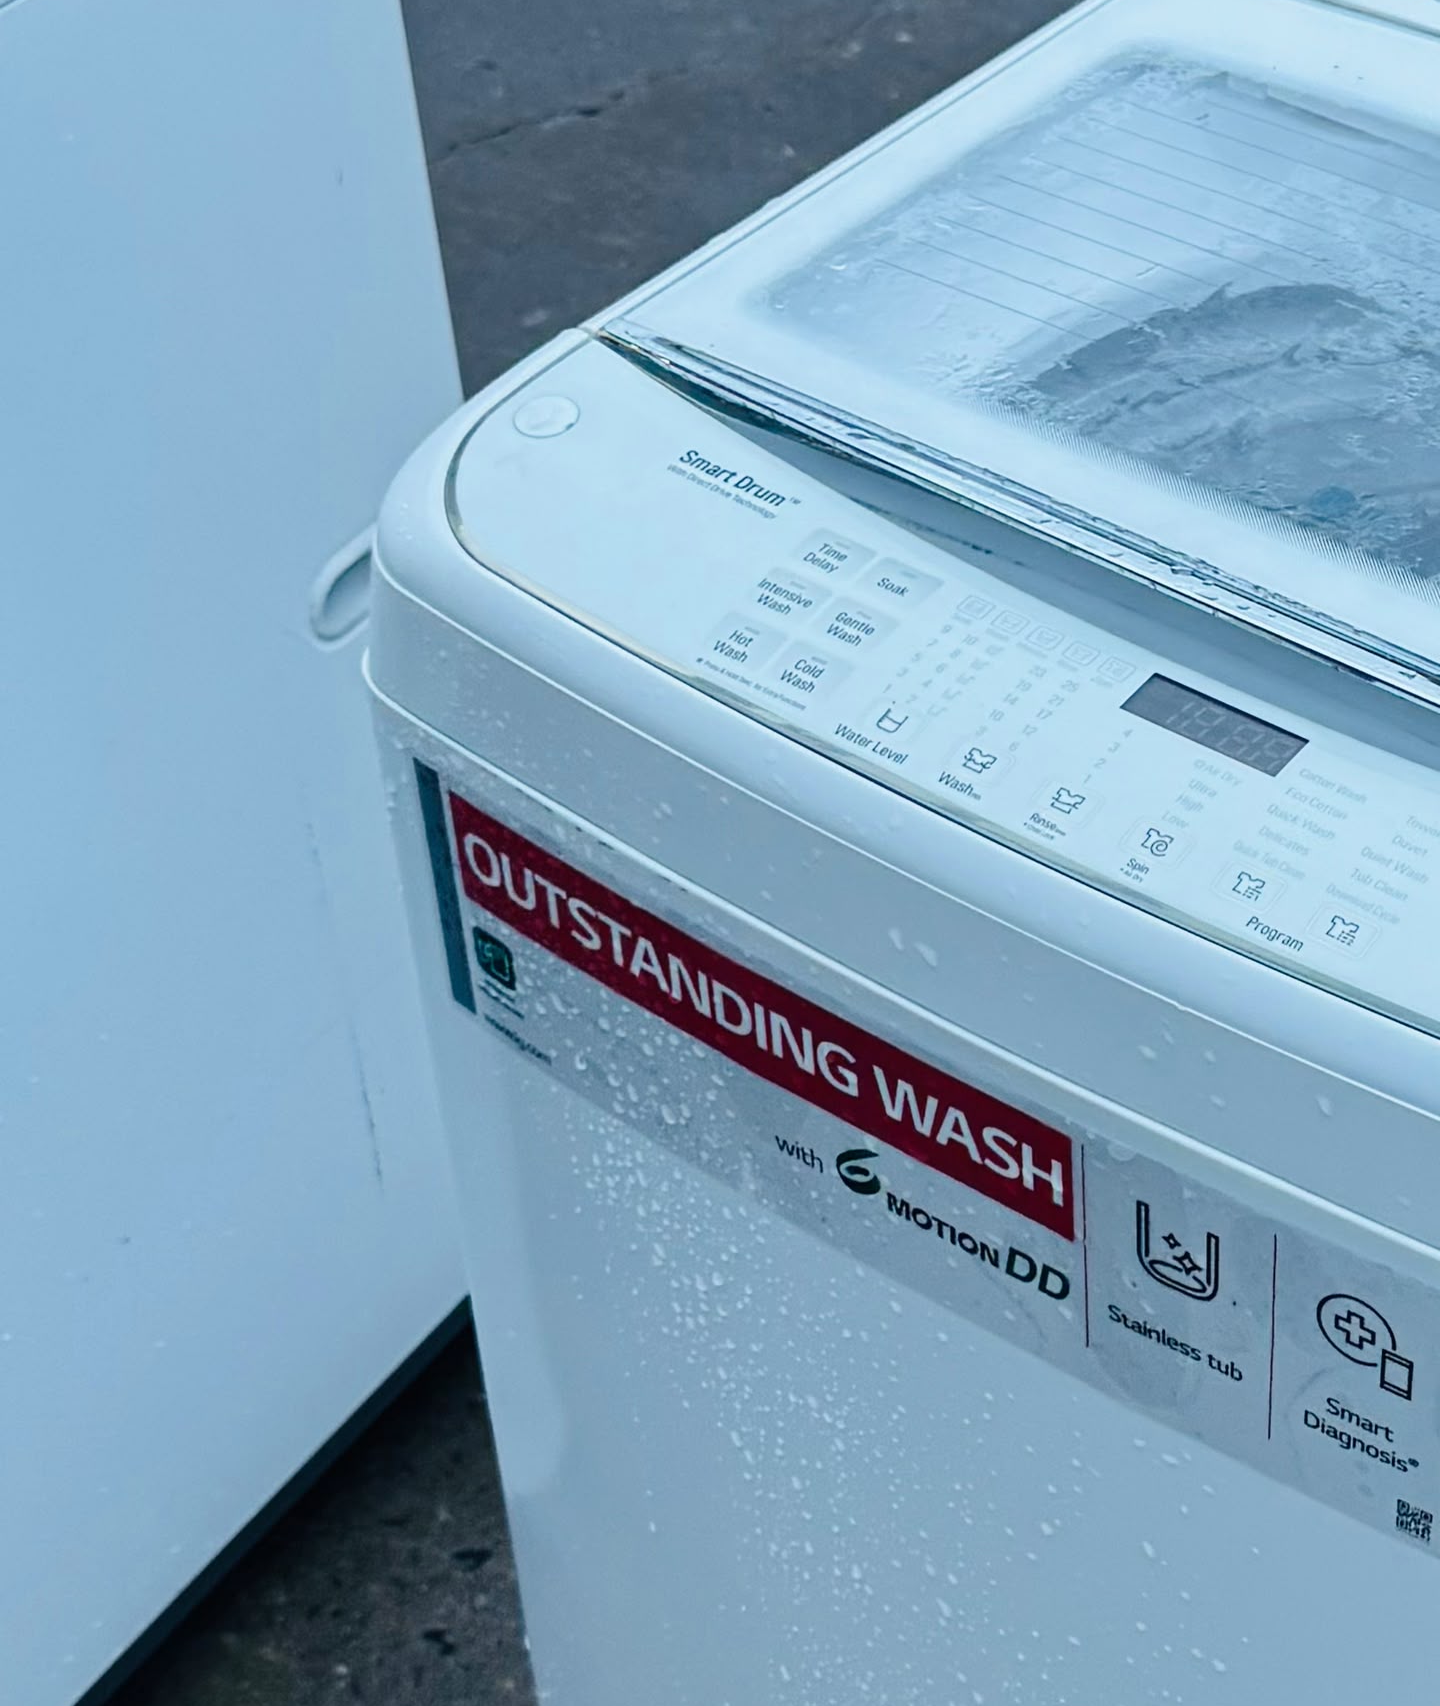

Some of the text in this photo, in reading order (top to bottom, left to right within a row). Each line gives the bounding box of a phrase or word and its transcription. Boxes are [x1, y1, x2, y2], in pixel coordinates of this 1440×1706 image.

[679, 450, 738, 483] Smart
[803, 552, 839, 573] Delay
[819, 543, 848, 562] Time
[757, 578, 813, 609] Intensive
[877, 577, 909, 597] Soak
[757, 593, 792, 615] Wash
[827, 623, 862, 647] Wash
[835, 611, 876, 636] Gentle
[728, 629, 754, 648] Hot
[713, 640, 748, 663] Wash
[794, 658, 825, 679] Cold
[780, 669, 816, 693] Wash
[834, 723, 909, 765] Water Level
[938, 771, 974, 795] Wash
[1188, 778, 1217, 797] Ultra
[1300, 768, 1368, 804] Cotton Wash
[1175, 793, 1204, 813] High
[1285, 787, 1349, 820] Eco Cotton
[1029, 812, 1057, 831] Rinse
[1161, 810, 1190, 829] Low
[1266, 803, 1336, 840] Quick Wash
[1391, 834, 1429, 857] Duvet
[1126, 857, 1150, 874] Spin
[1360, 846, 1430, 884] Quiet Wash
[1350, 867, 1408, 901] Tub Clean
[1245, 915, 1304, 952] Program
[464, 833, 1066, 1207] OUTSTANDING WASH
[775, 1135, 824, 1174] with
[887, 1192, 1000, 1269] MOTION
[1005, 1245, 1071, 1301] DD
[1107, 1304, 1243, 1382] Stainless tub
[1325, 1397, 1394, 1443] Smart
